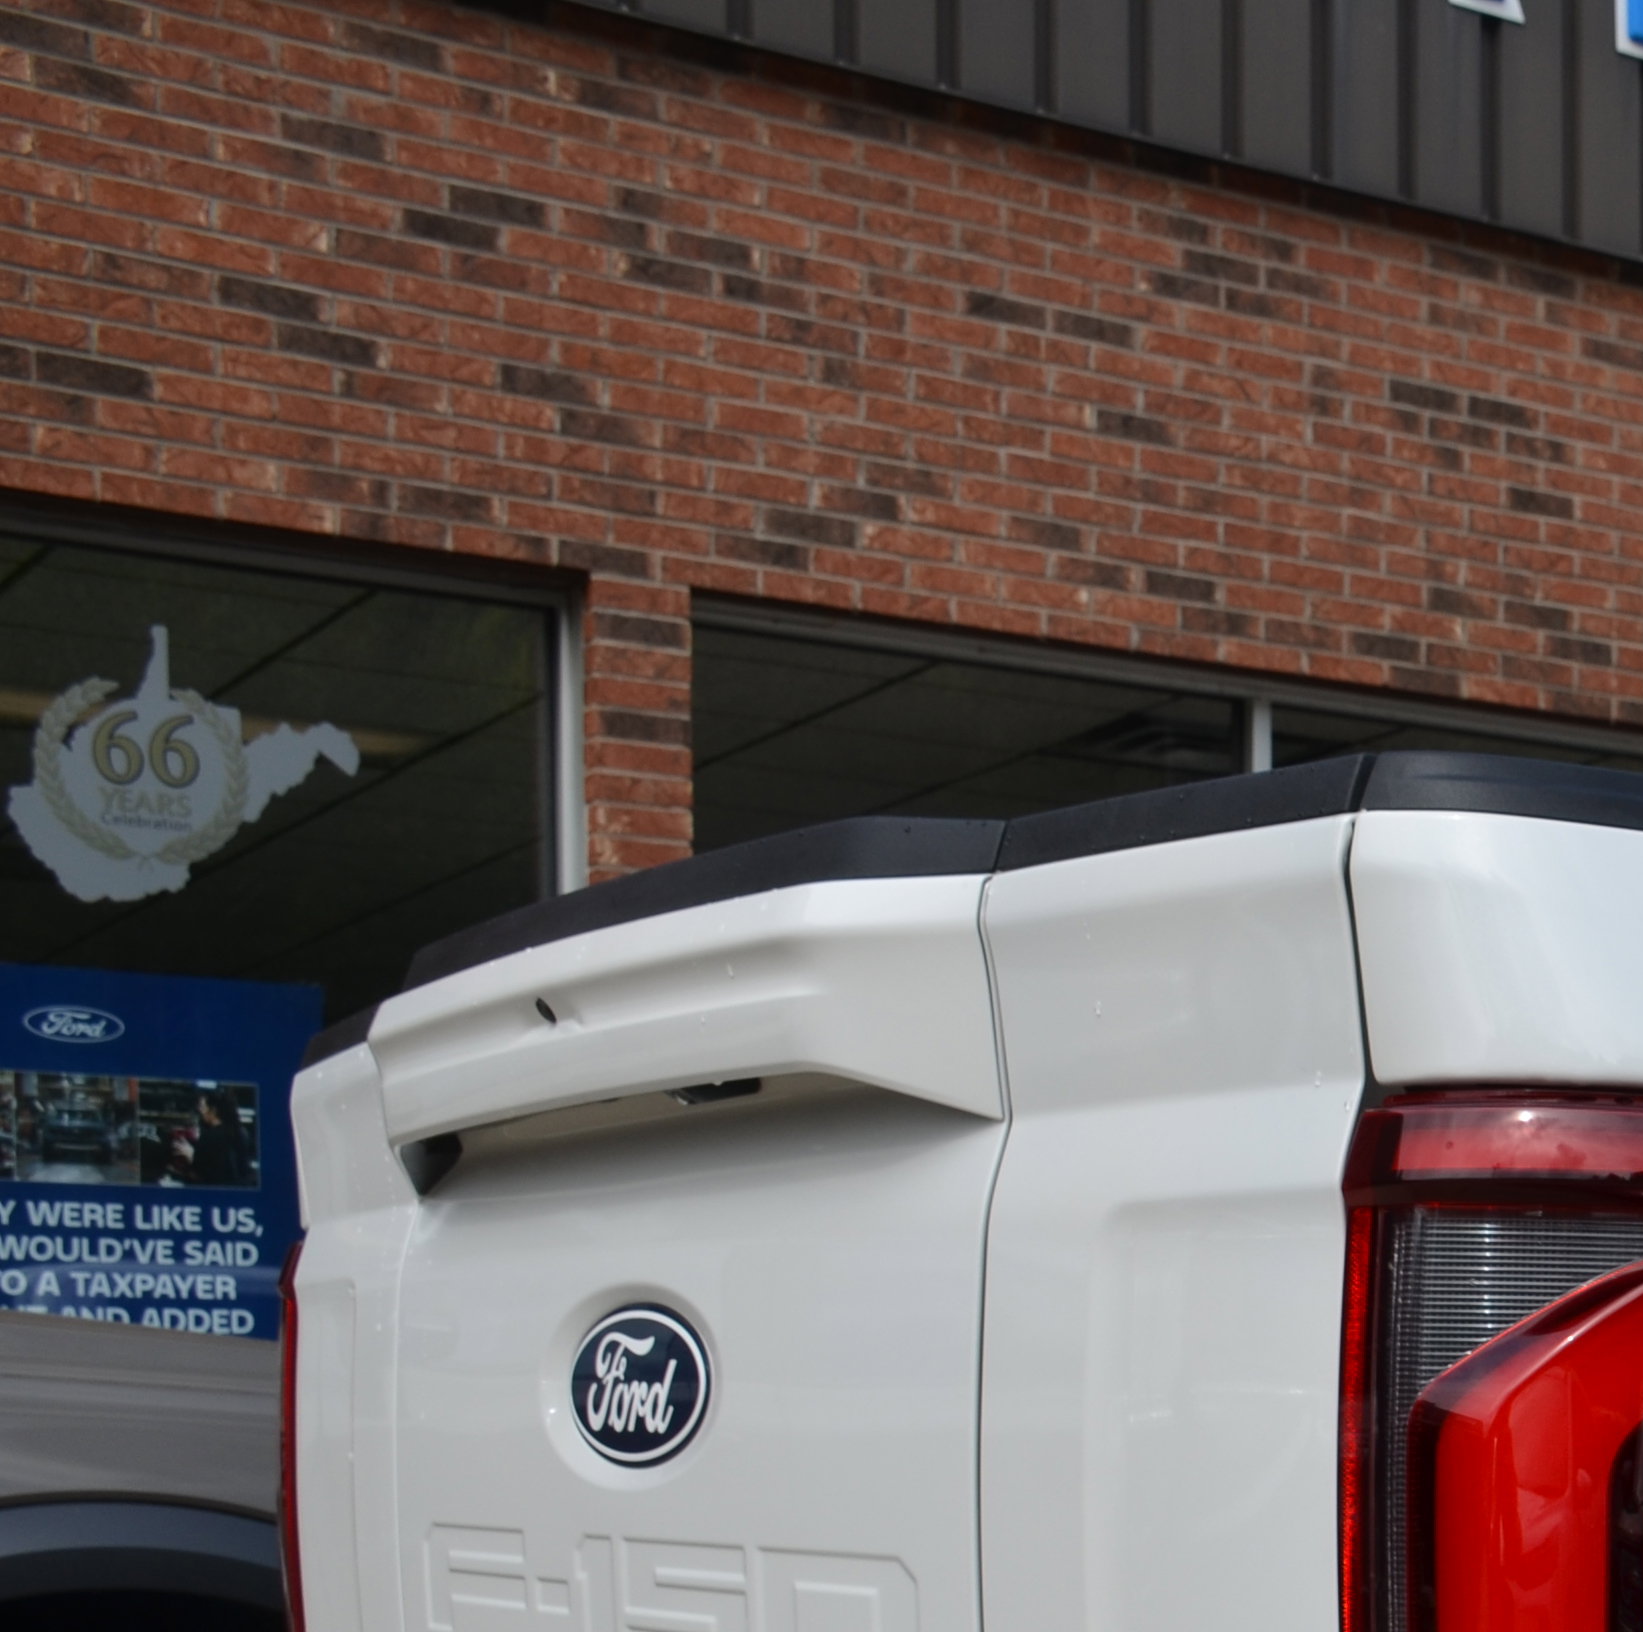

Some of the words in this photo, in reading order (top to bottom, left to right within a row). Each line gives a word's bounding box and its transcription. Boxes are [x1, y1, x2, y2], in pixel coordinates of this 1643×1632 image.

[93, 710, 200, 788] 66
[97, 786, 193, 817] YEARS
[100, 812, 193, 832] Celebration
[41, 1009, 107, 1038] Ford
[26, 1199, 125, 1229] WERE
[134, 1203, 203, 1232] LIKE
[211, 1205, 264, 1238] US,
[0, 1234, 175, 1265] WOULD'VE
[183, 1239, 259, 1267] SAID
[0, 1268, 27, 1296] O
[36, 1269, 61, 1297] A
[69, 1270, 237, 1301] TAXPAYER
[141, 1306, 255, 1336] ADDED
[586, 1331, 678, 1435] Ford
